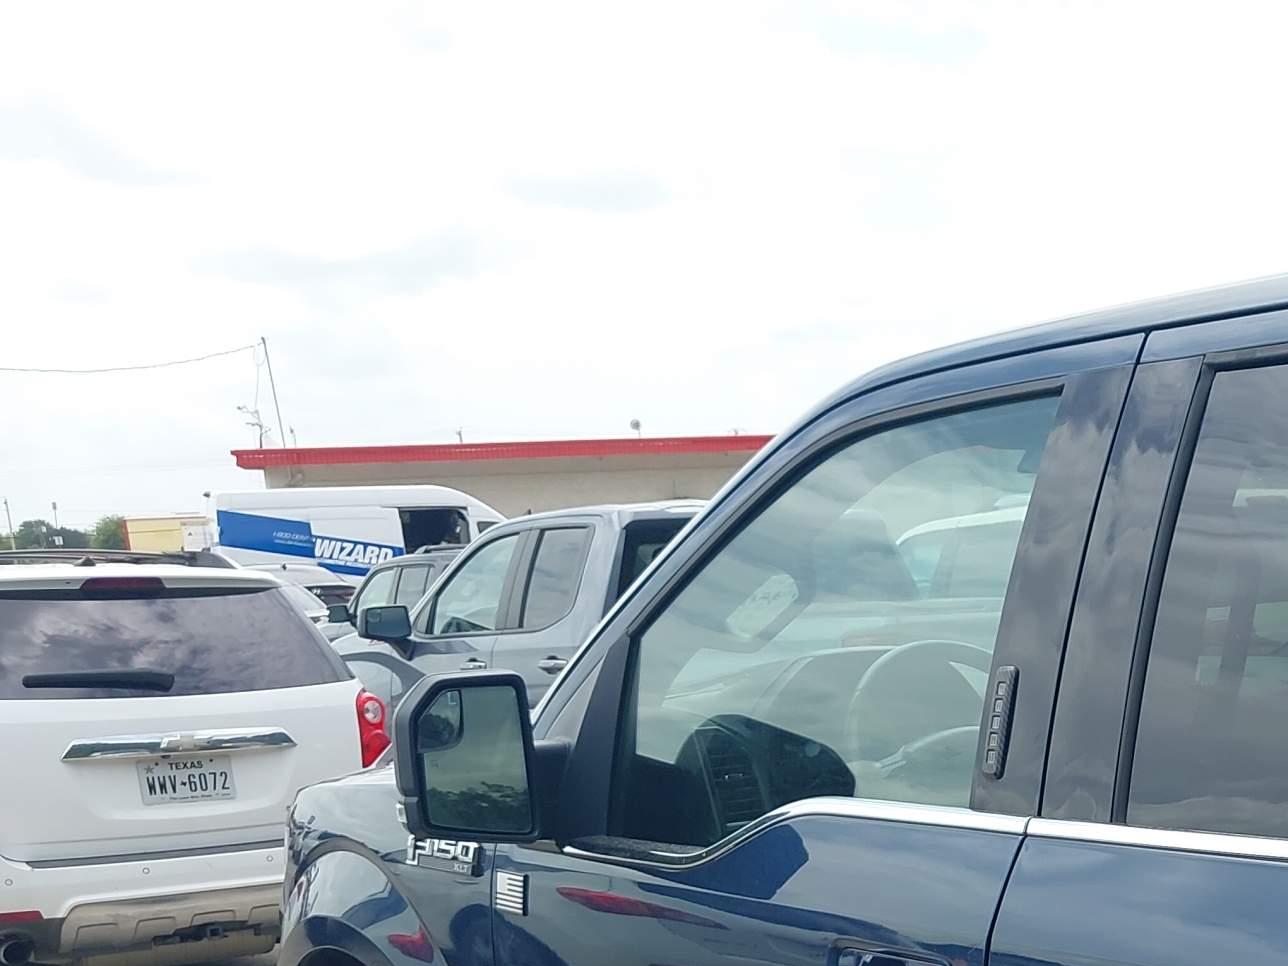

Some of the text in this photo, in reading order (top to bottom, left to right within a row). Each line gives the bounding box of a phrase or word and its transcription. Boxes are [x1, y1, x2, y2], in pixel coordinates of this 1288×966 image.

[314, 537, 394, 566] WIZARD
[168, 761, 203, 771] TEXAS
[453, 863, 469, 873] XLT
